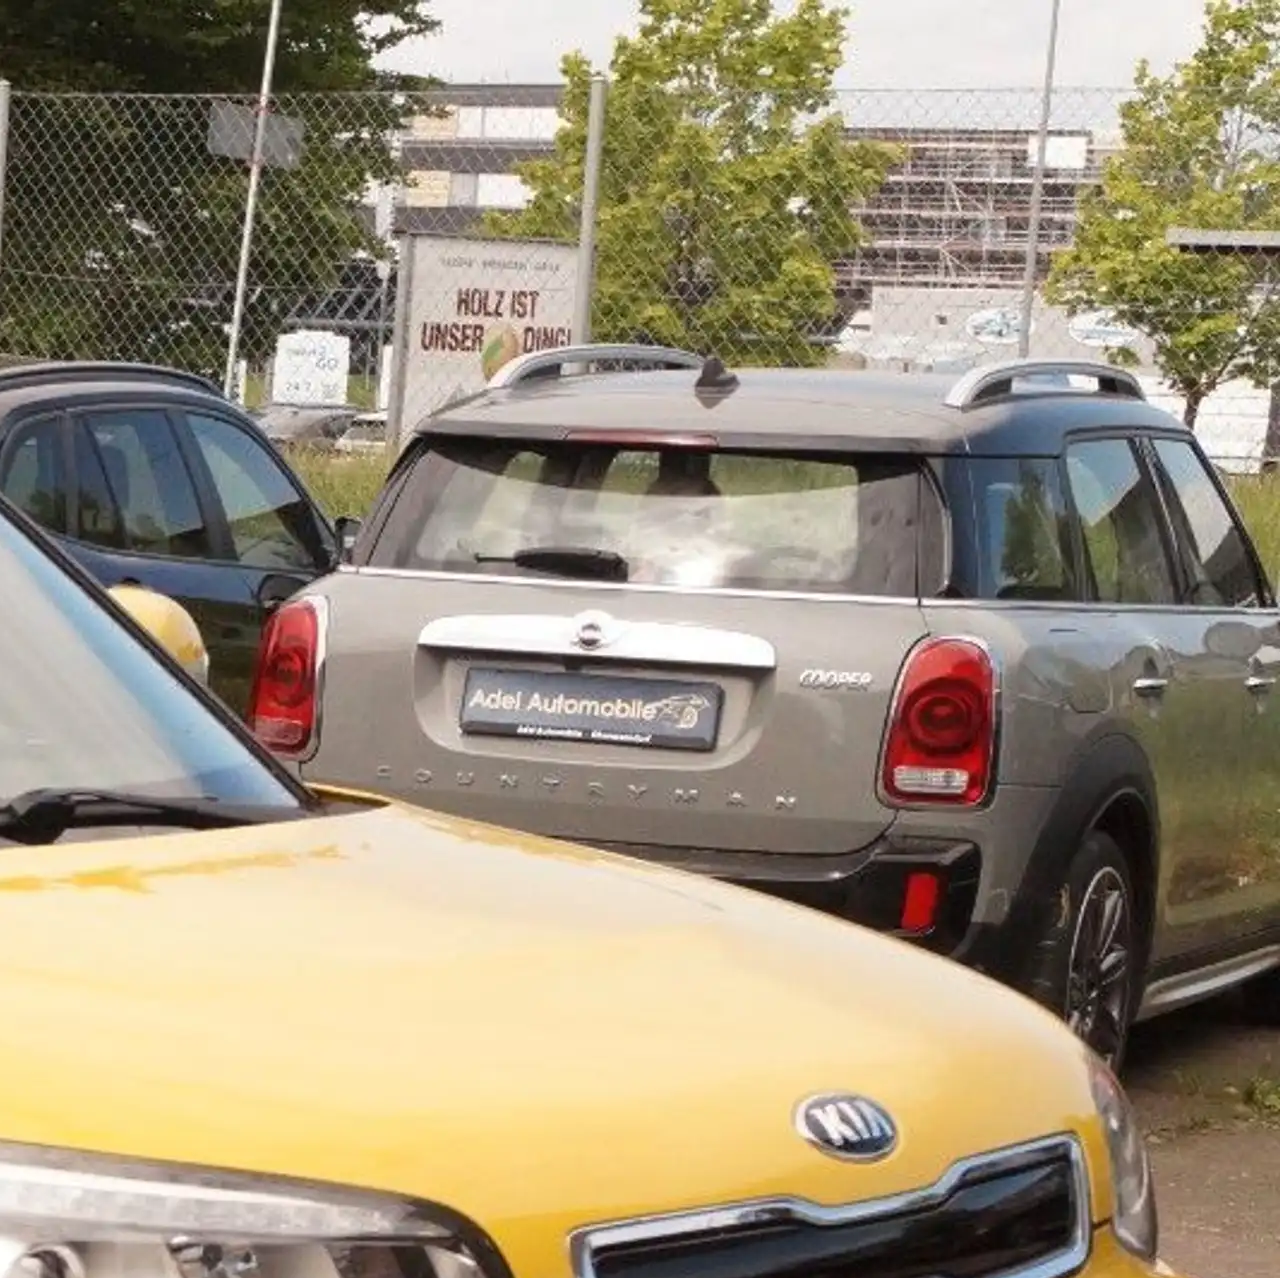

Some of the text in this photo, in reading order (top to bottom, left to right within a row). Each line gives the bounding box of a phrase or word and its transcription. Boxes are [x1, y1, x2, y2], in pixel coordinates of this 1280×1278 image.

[456, 288, 540, 320] HOLZ IST
[420, 322, 484, 352] UNSER
[800, 670, 872, 691] COOPER
[468, 687, 656, 721] Adel Automobile
[376, 765, 798, 810] COUNTRYMAN
